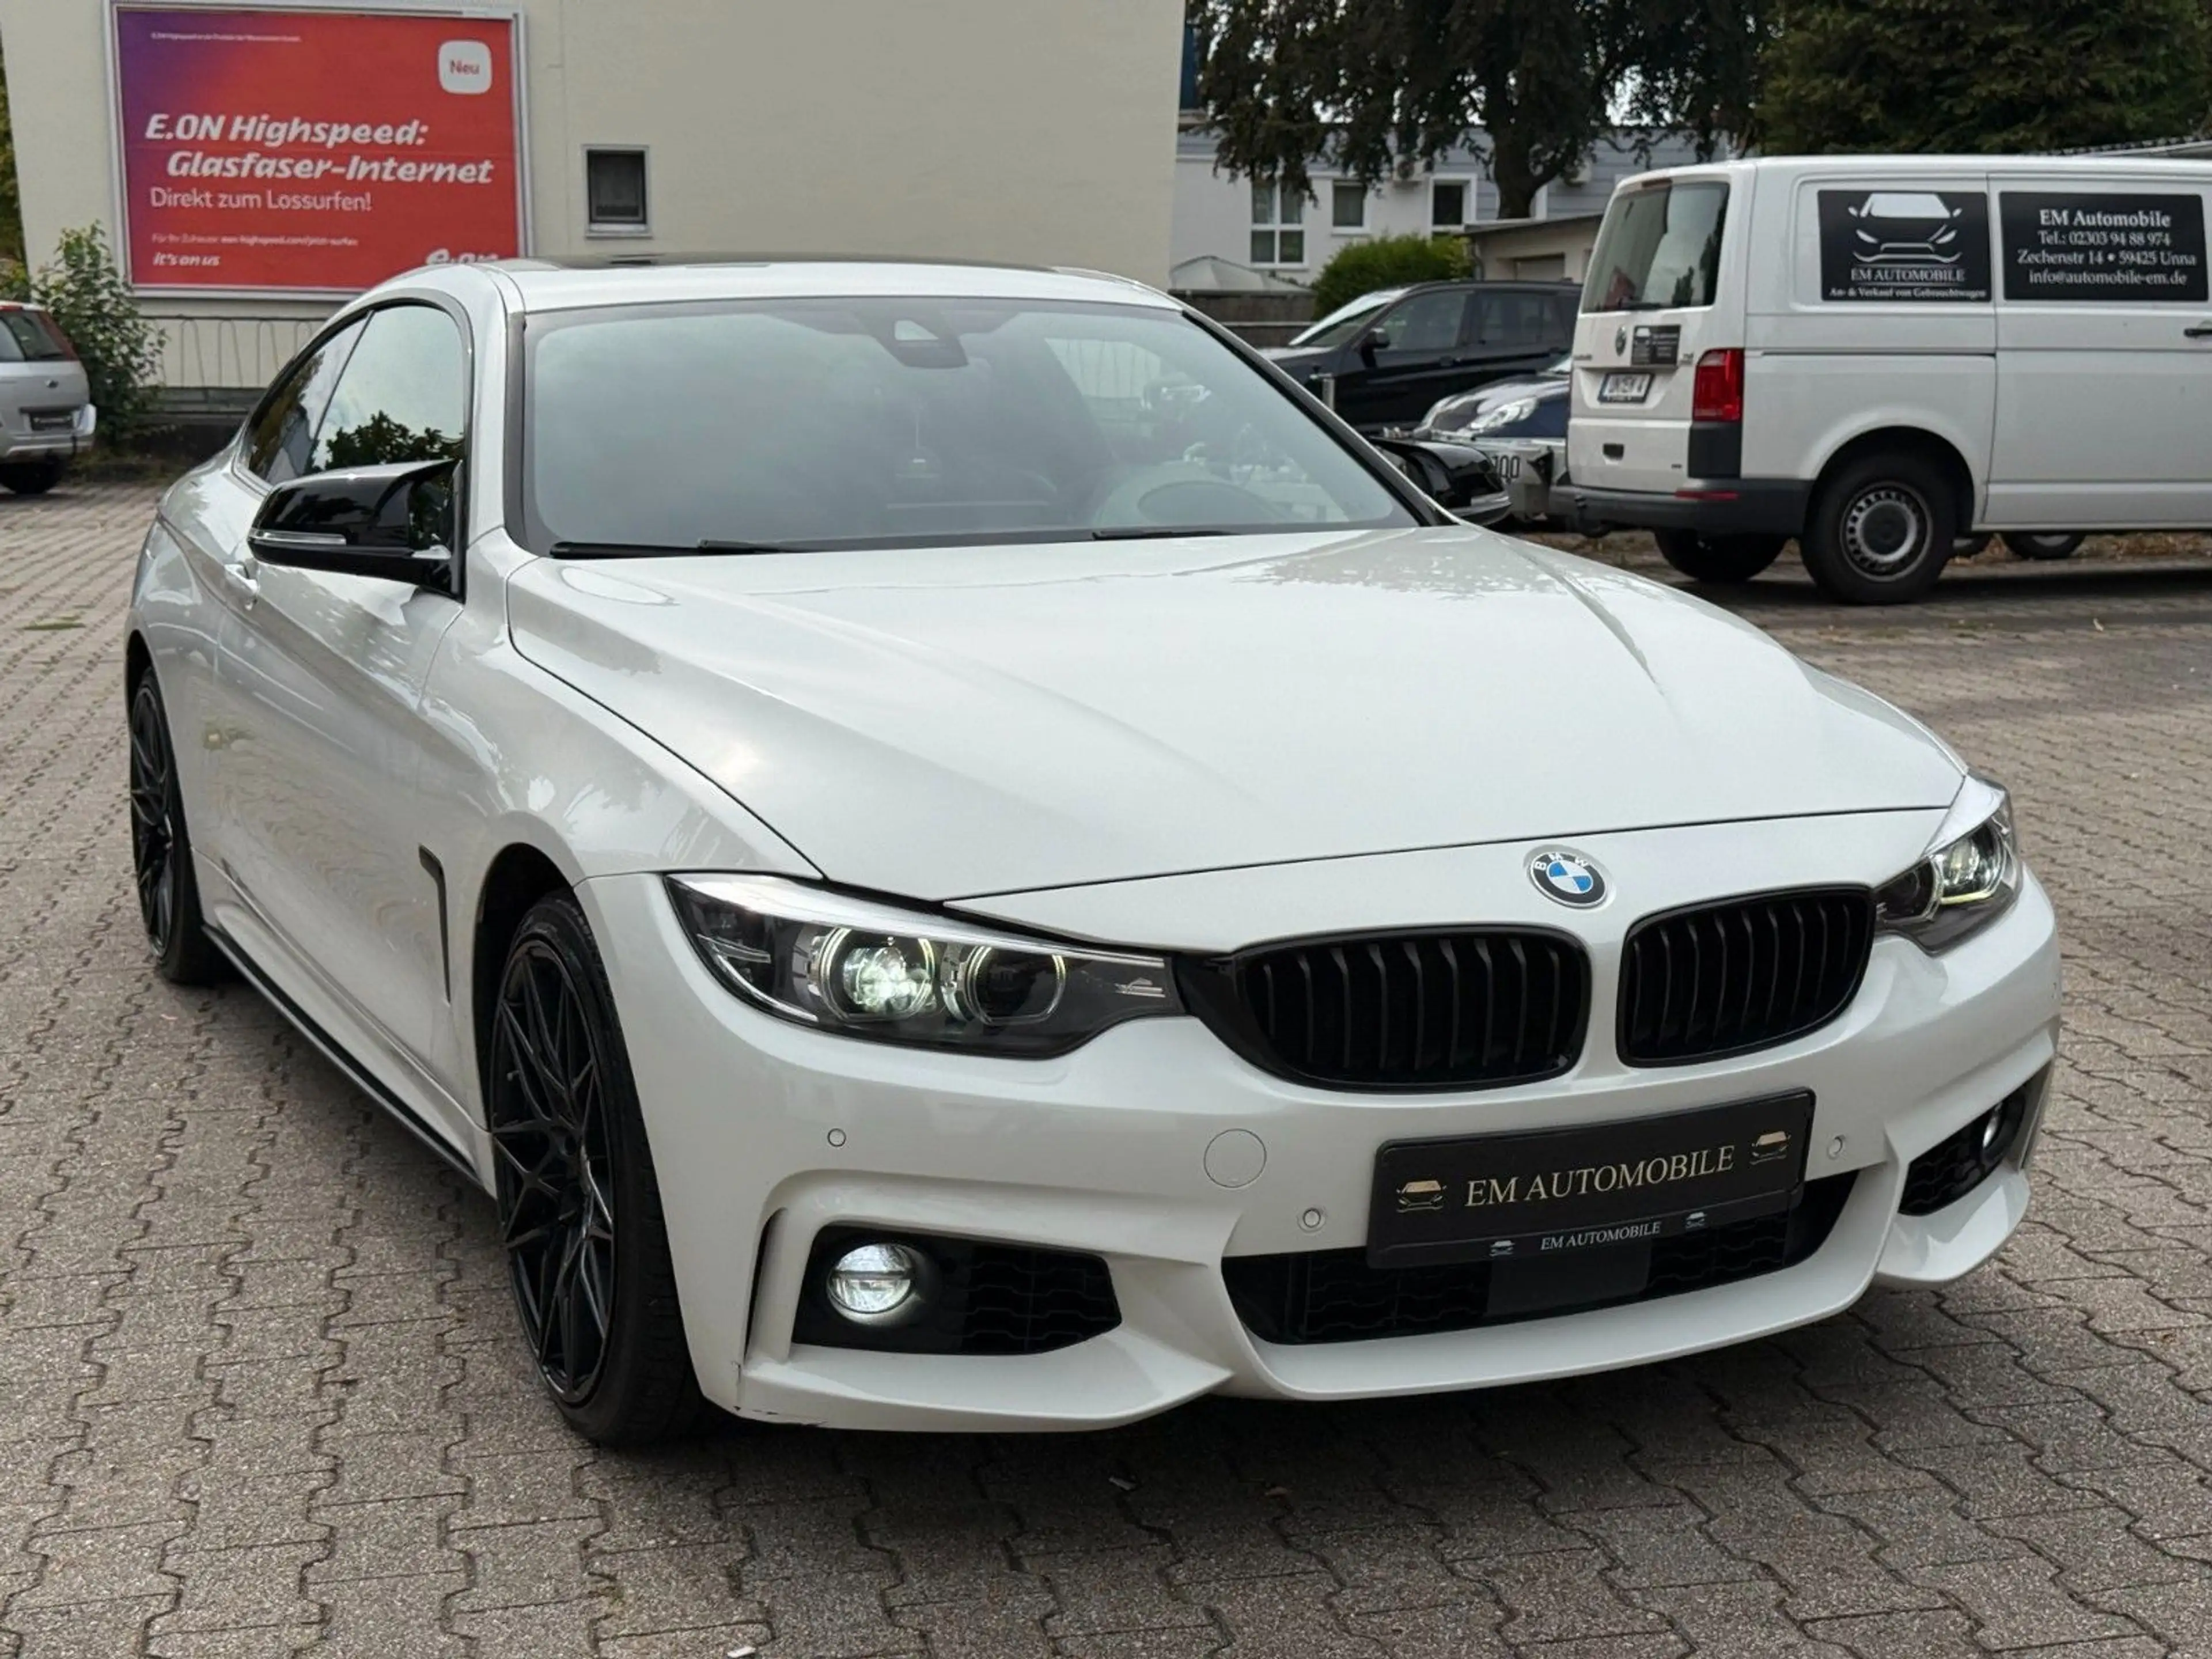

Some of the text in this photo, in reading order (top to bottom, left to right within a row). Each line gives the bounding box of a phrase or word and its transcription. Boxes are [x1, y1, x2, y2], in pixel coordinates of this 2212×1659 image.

[449, 59, 480, 75] Neu
[145, 113, 429, 149] E.ON Highspeed:
[166, 150, 494, 184] Glasfaser-Internet
[150, 186, 372, 211] Direkt zum Lossurfen!
[2039, 209, 2171, 227] EM Automobile
[2160, 252, 2197, 266] Unna
[1851, 268, 1965, 282] EM AUTOMOBILE
[1534, 852, 1588, 871] BMW
[1464, 1145, 1734, 1207] EM AUTOMOBILE
[1540, 1221, 1661, 1251] EM AUTOMOBILE
